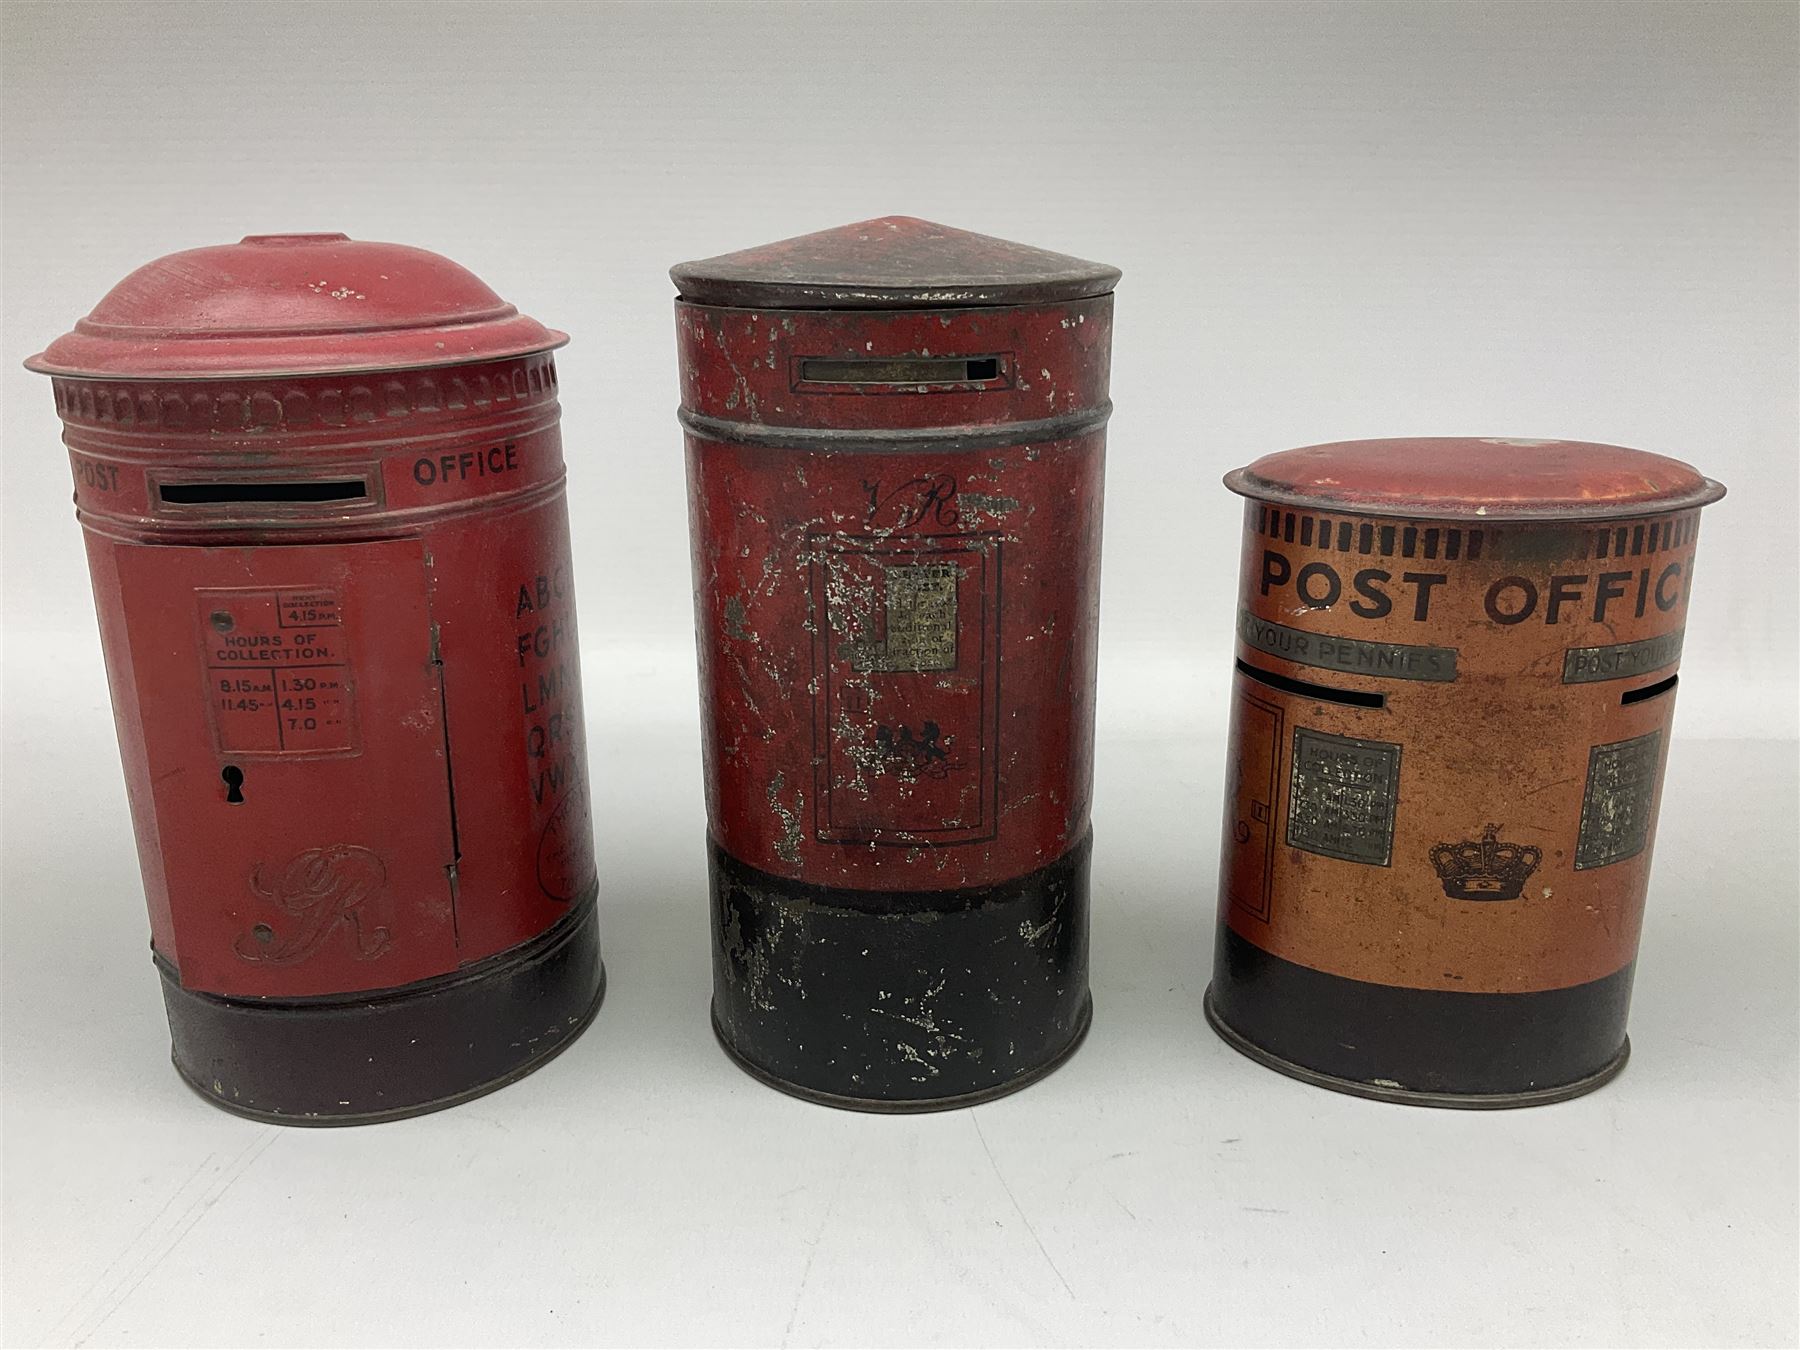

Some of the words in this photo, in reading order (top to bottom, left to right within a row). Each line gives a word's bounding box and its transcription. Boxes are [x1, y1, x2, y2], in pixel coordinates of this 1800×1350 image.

[75, 461, 119, 492] POST
[413, 444, 518, 486] OFFICE
[1260, 549, 1446, 622] POST
[288, 609, 317, 622] 4.15
[225, 635, 282, 648] HOURS
[294, 634, 316, 645] OF
[1255, 623, 1309, 655] YOUR
[1319, 641, 1442, 673] PENNIES
[217, 648, 335, 661] COLLECTION.
[1574, 650, 1624, 676] POST
[220, 679, 251, 693] 8.15
[281, 678, 316, 692] 1.30
[222, 698, 259, 712] 11.45
[281, 697, 317, 711] 4.15
